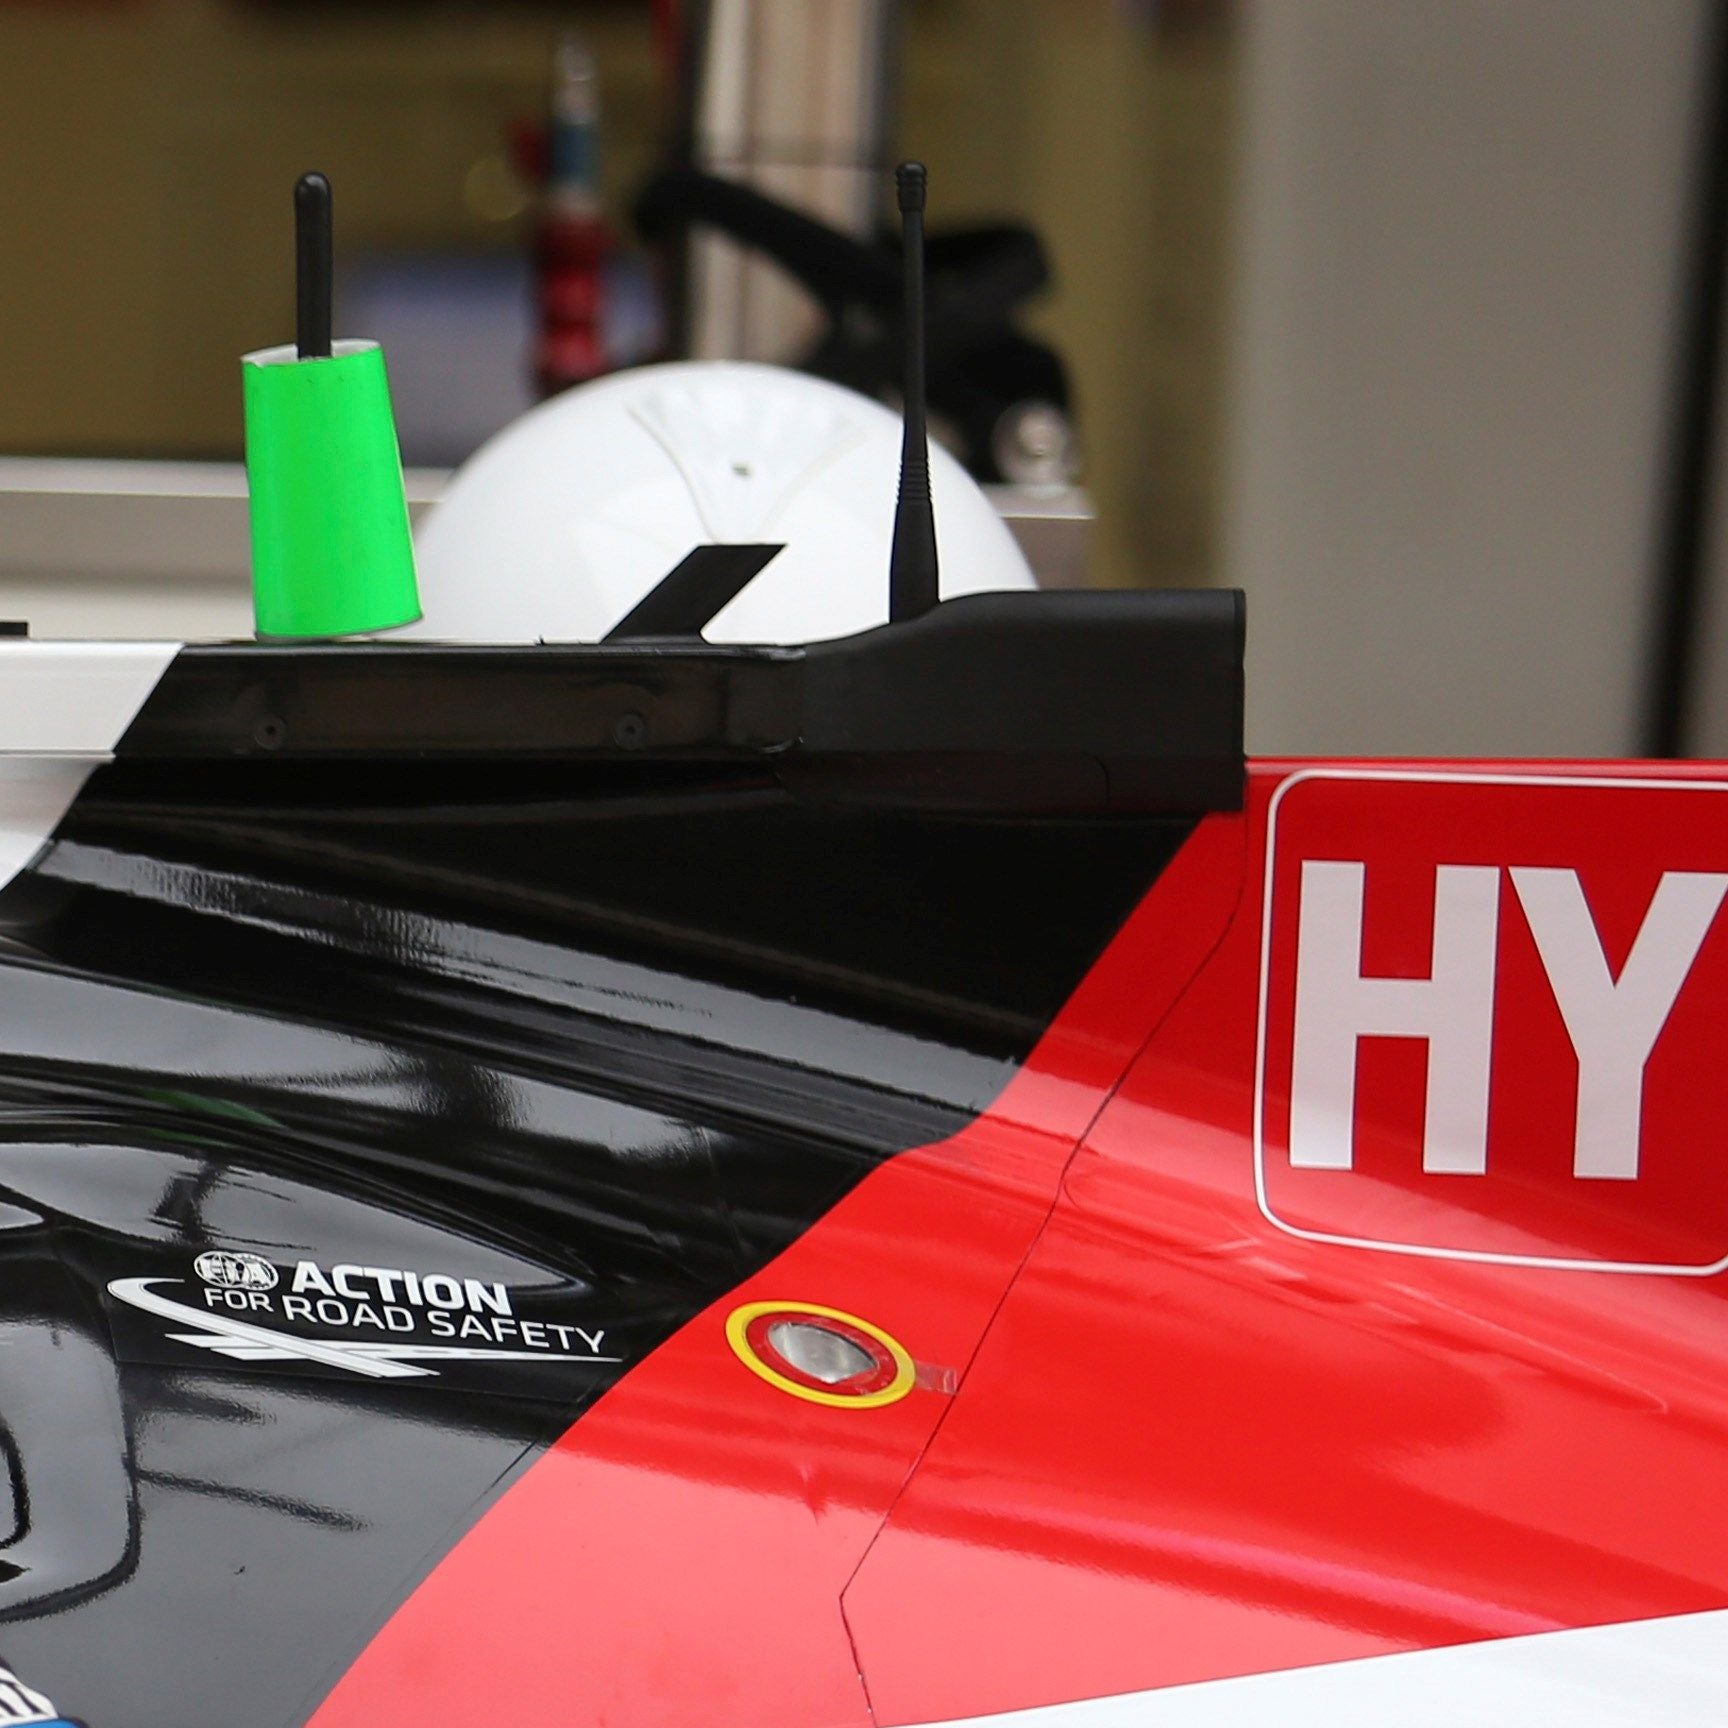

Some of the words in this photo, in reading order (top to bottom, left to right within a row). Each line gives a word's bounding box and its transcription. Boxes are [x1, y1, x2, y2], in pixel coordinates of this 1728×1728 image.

[292, 1260, 513, 1316] ACTION
[204, 1287, 274, 1313] FOR
[282, 1294, 417, 1333] ROAD
[426, 1308, 606, 1354] SAFETY
